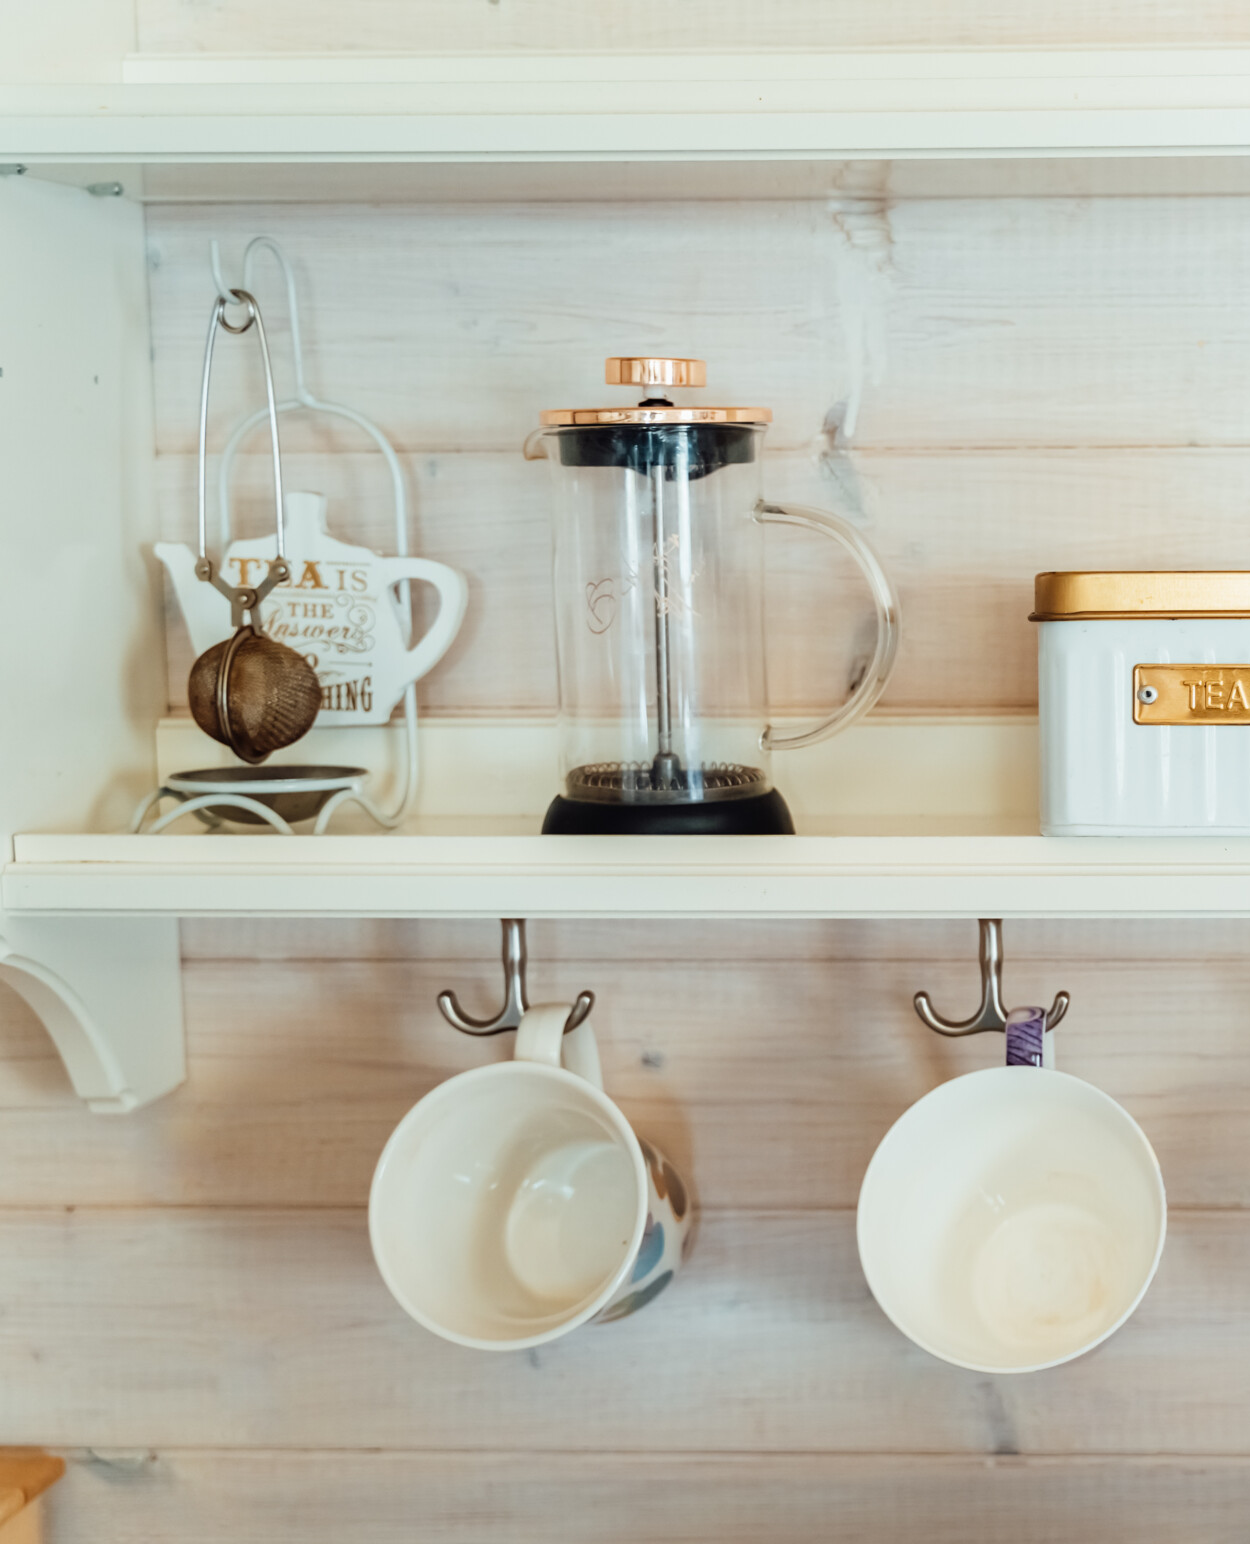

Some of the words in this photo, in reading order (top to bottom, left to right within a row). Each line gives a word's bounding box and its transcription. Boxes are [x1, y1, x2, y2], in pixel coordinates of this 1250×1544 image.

[337, 570, 368, 592] IS
[287, 602, 335, 619] THE
[1182, 679, 1250, 711] TEA
